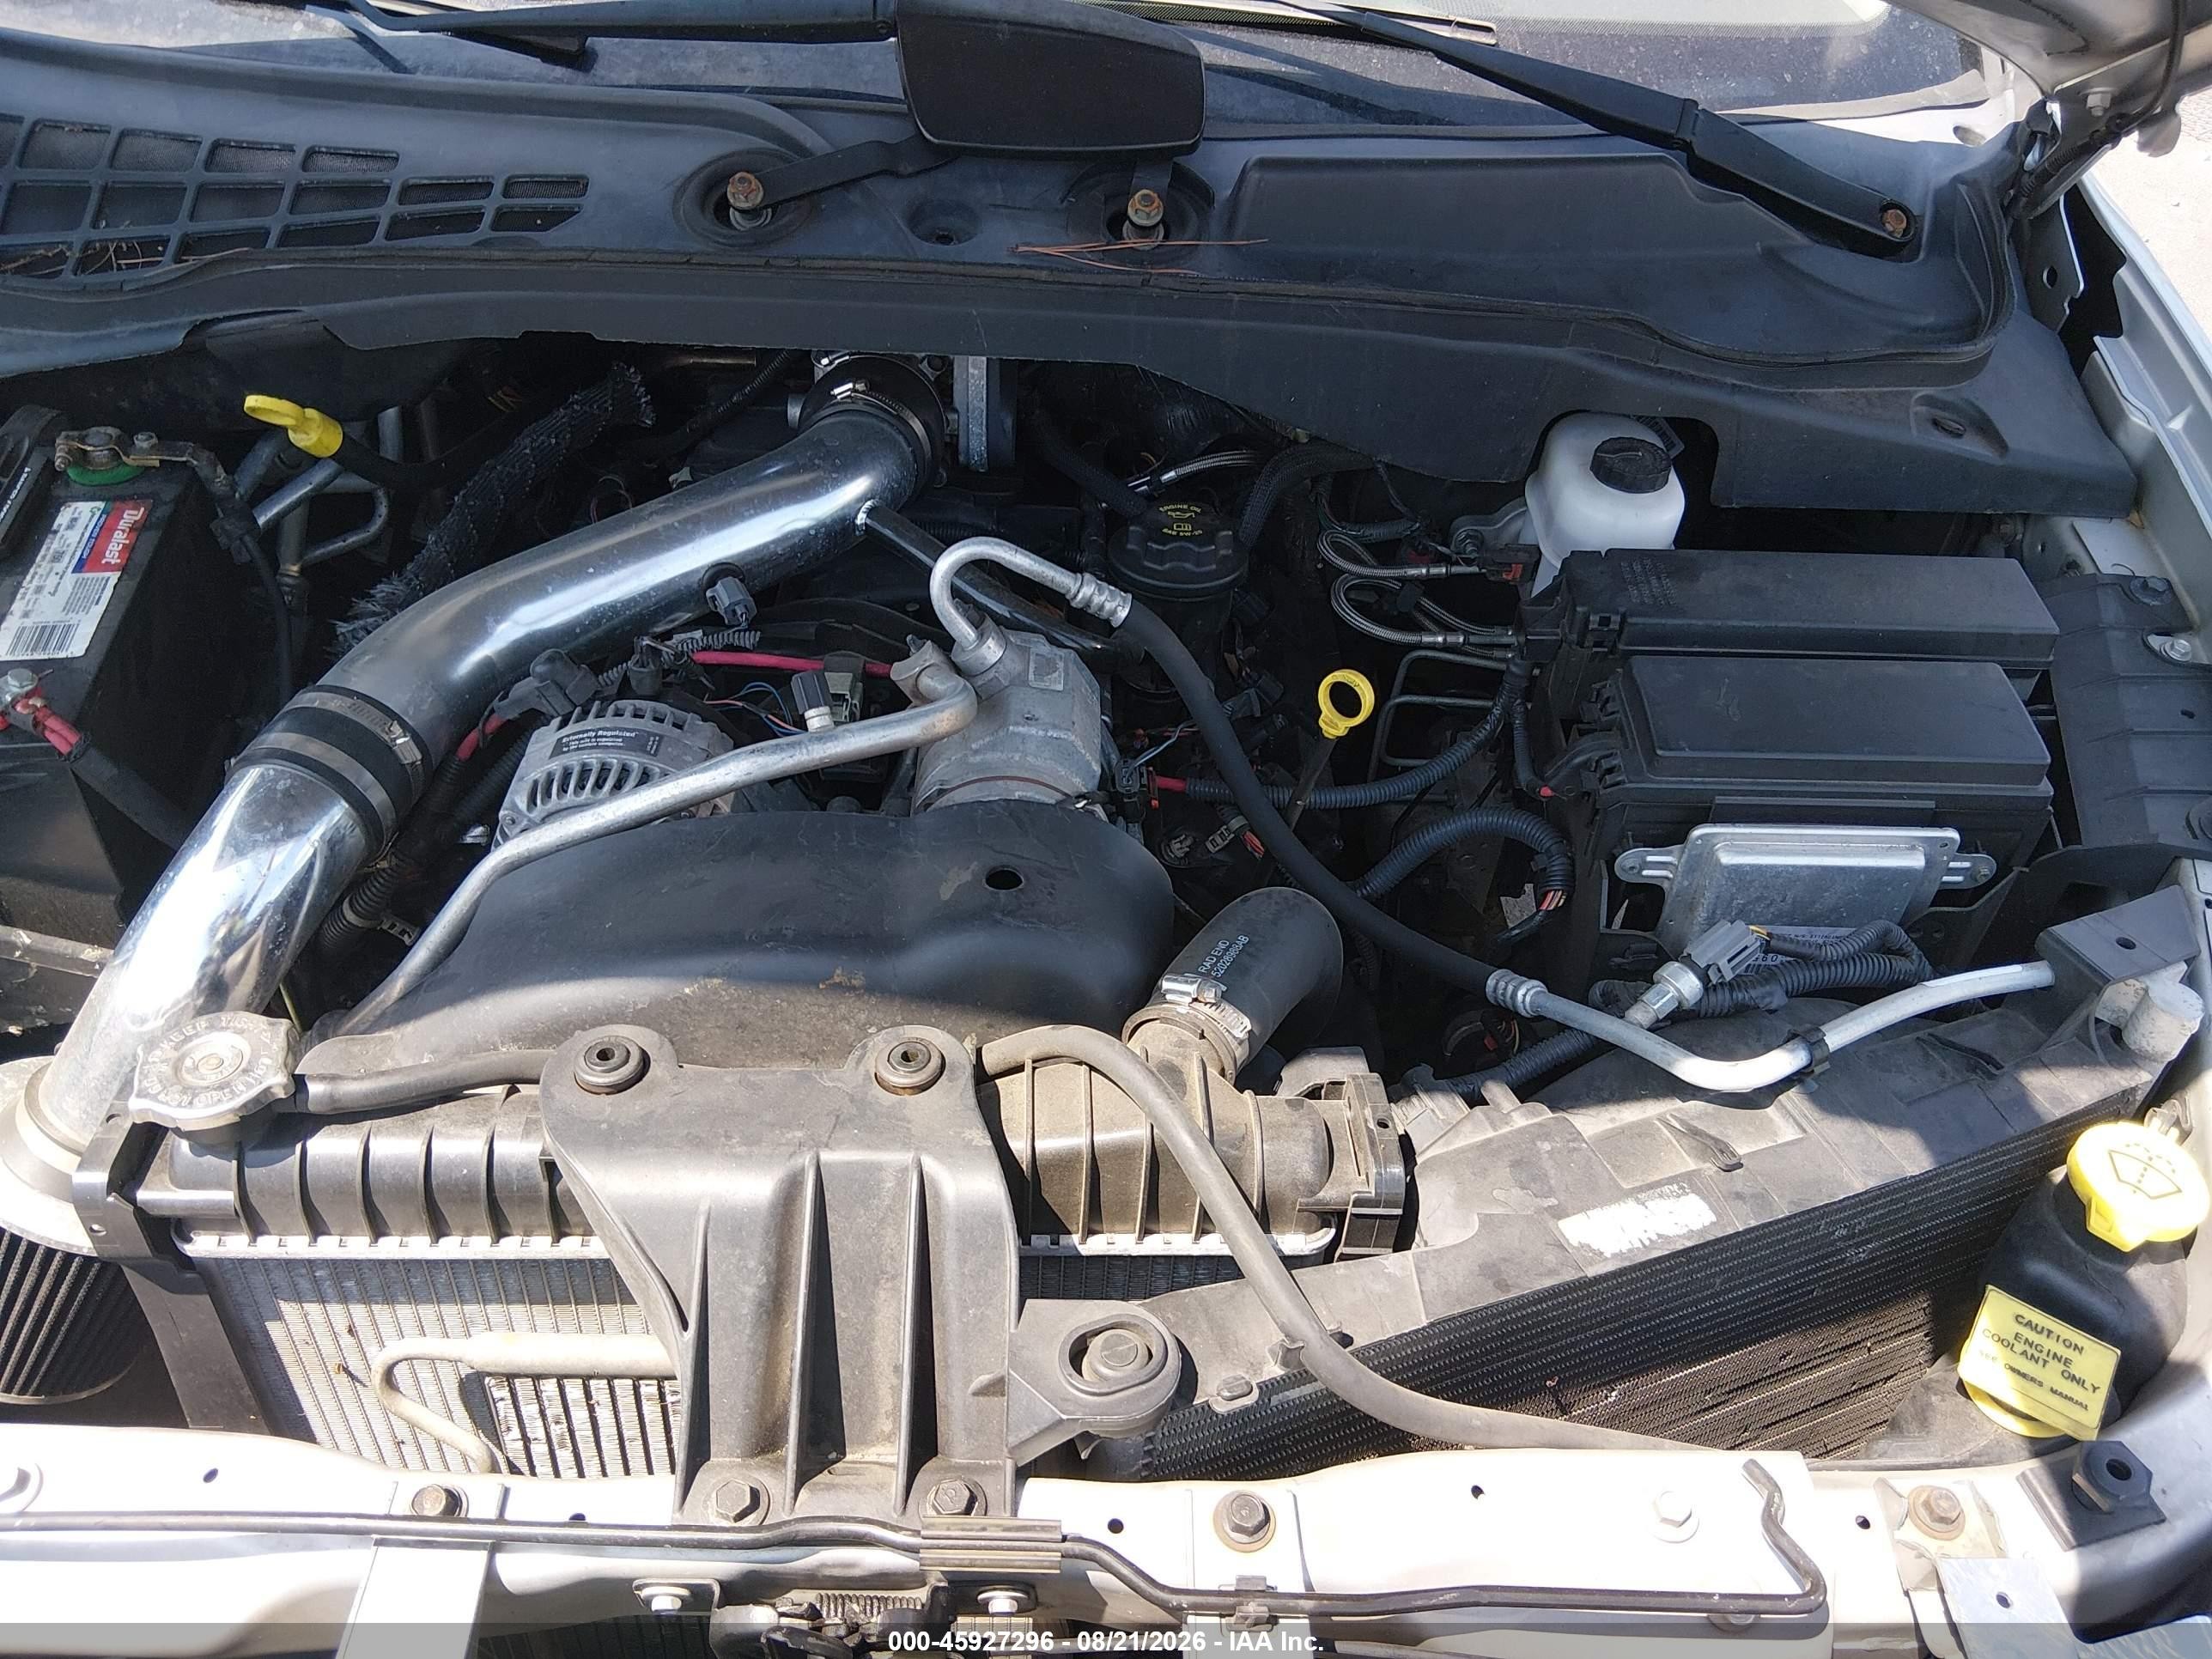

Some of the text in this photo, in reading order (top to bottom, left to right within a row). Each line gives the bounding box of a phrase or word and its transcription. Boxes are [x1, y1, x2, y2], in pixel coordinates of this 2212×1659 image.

[100, 507, 145, 564] Duralast
[1198, 939, 1230, 973] RAD END
[2013, 1332, 2074, 1369] ENGINE
[2015, 1314, 2085, 1356] CAUTION
[1982, 1328, 2100, 1394] COOLANT ONLY
[2003, 1363, 2044, 1388] OWNERS
[2049, 1386, 2089, 1412] MANUAL
